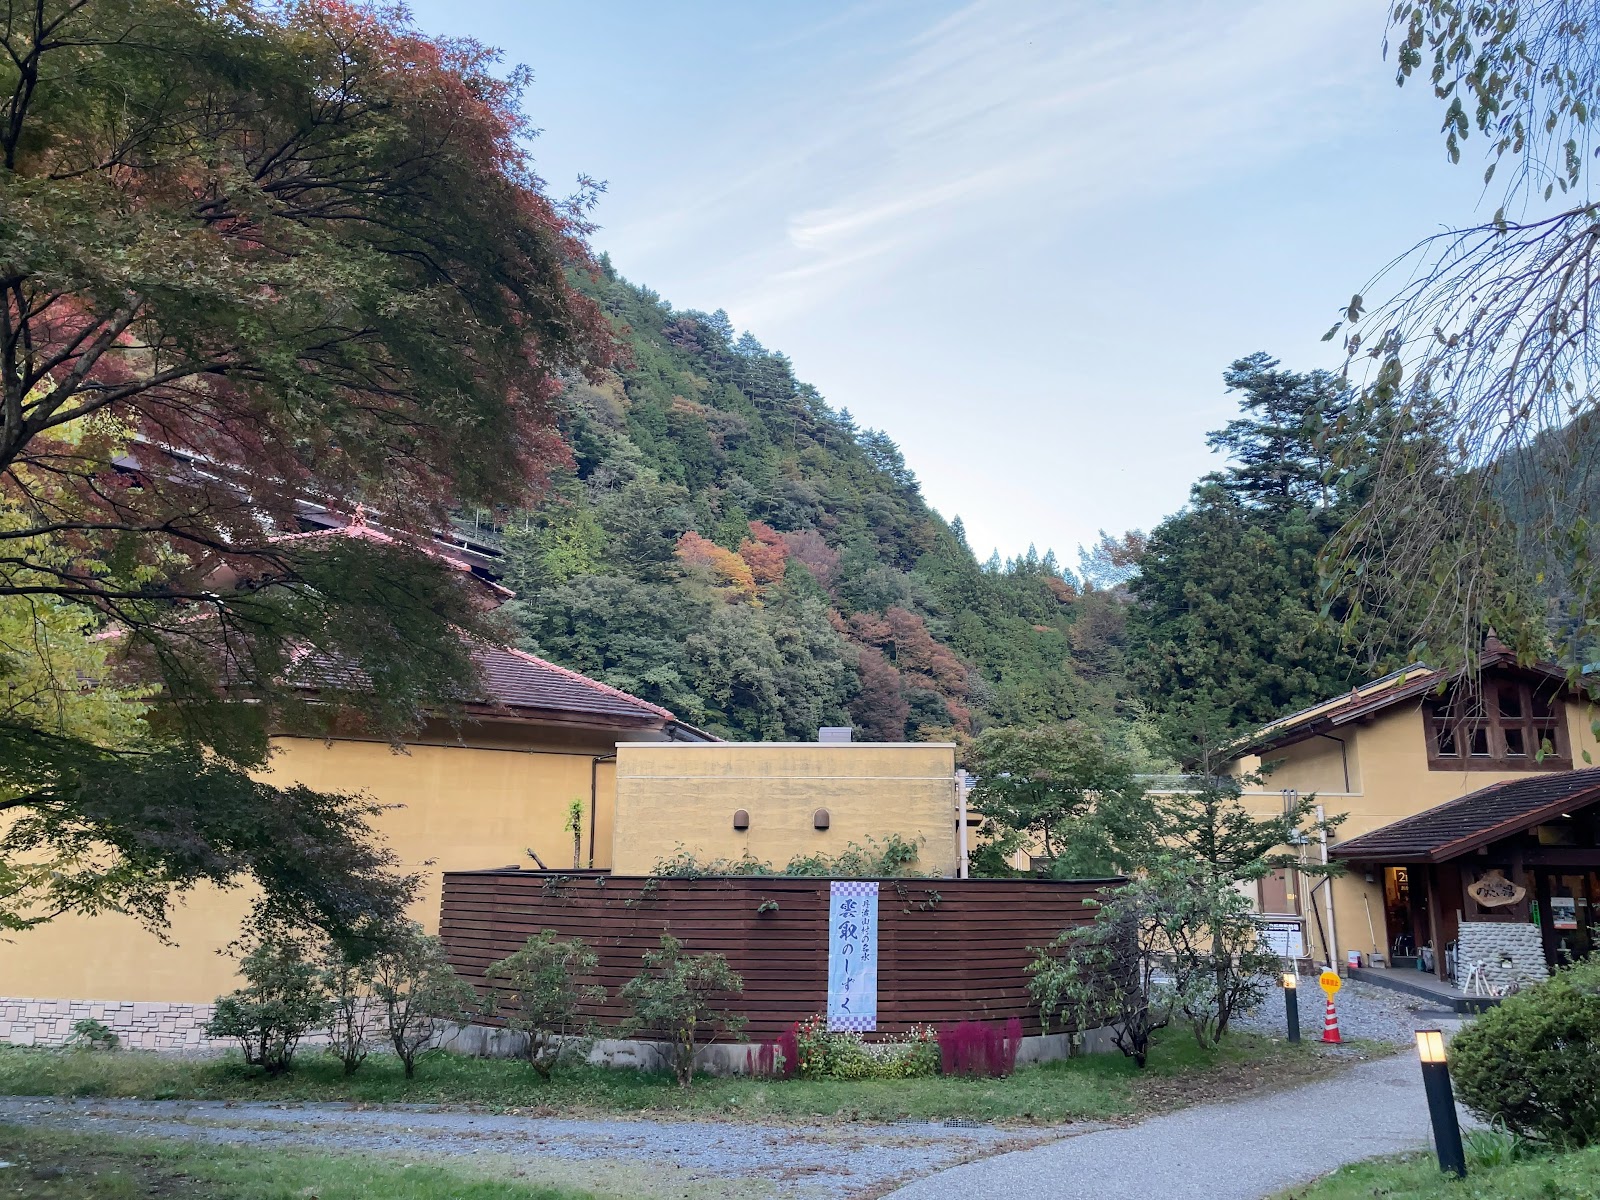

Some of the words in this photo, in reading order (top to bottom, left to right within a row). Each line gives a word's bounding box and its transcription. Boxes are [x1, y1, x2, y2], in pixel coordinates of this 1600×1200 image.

[838, 898, 858, 1014] 雲取のしずく
[860, 899, 871, 962] 丹波山村の名水
